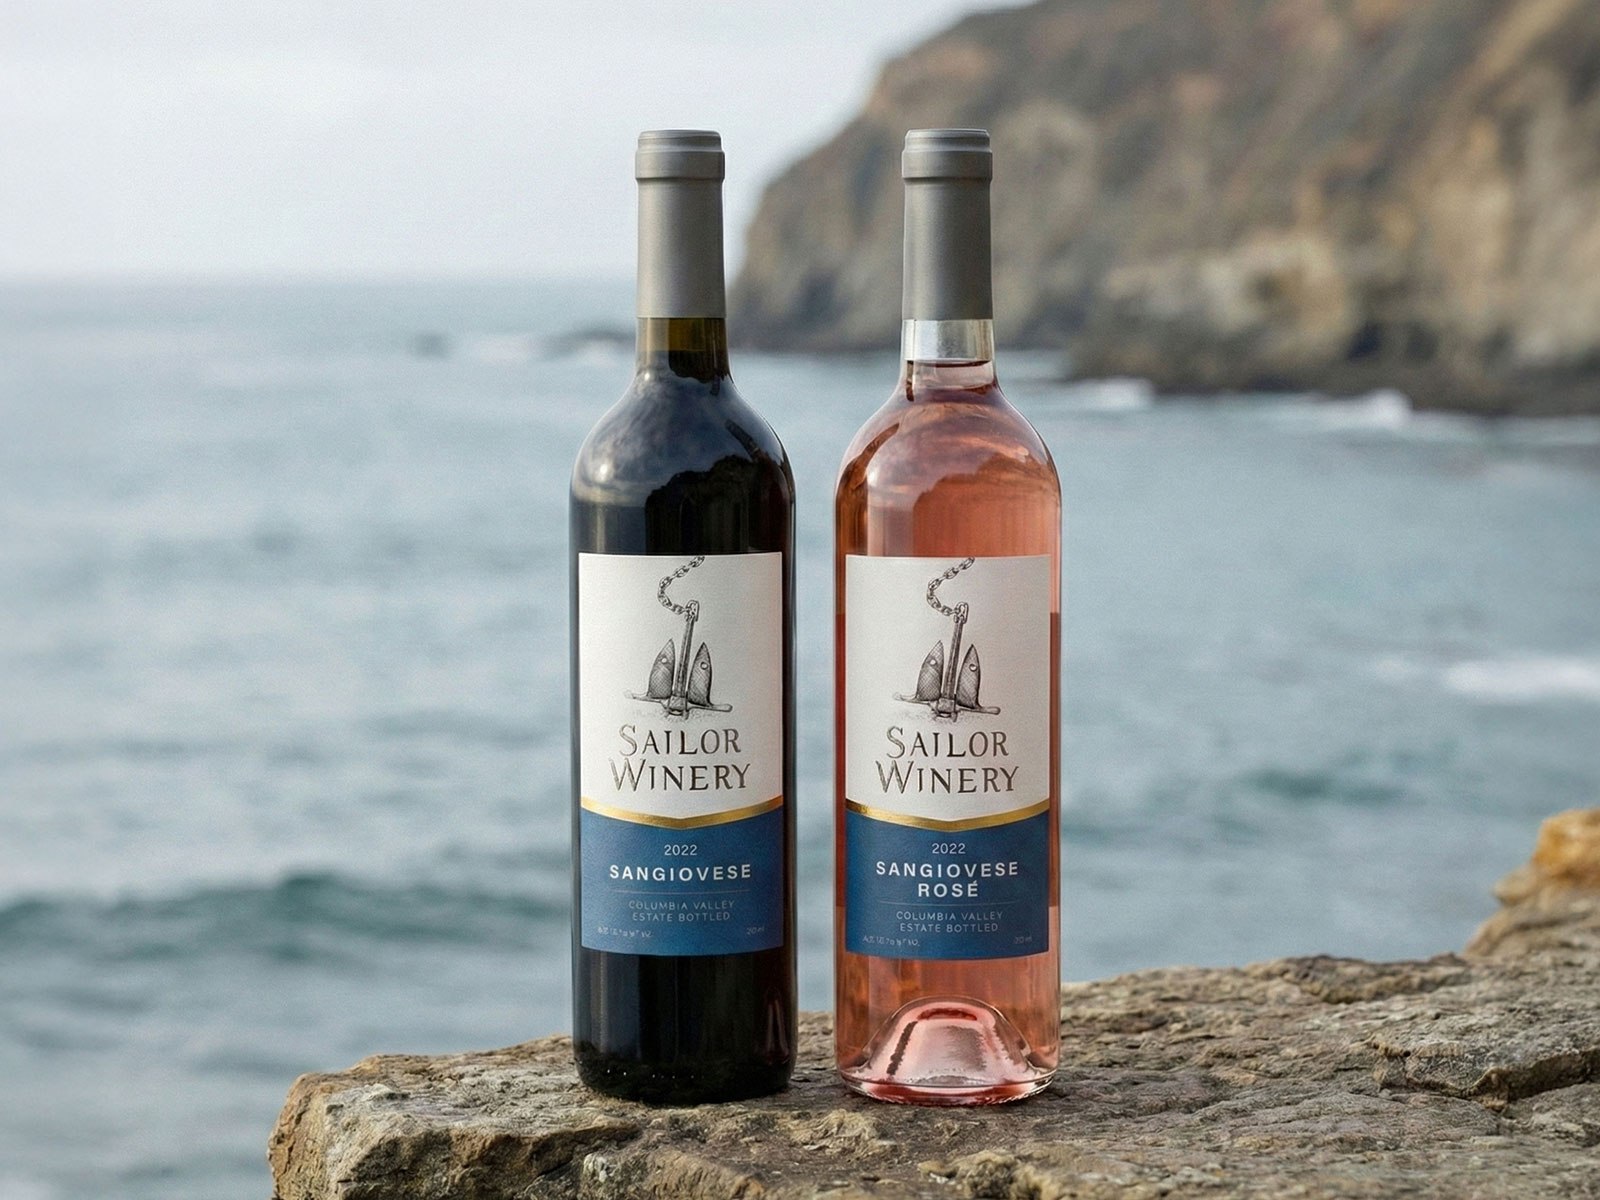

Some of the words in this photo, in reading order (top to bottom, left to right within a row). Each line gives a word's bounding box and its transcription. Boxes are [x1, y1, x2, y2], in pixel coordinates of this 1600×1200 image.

[619, 725, 742, 756] SAILOR
[886, 726, 1009, 759] SAILOR
[609, 757, 751, 792] WINERY
[876, 760, 1020, 794] WINERY
[664, 844, 698, 856] 2022
[931, 842, 966, 855] 2022
[609, 864, 751, 882] SANGIOVESE
[876, 861, 1018, 878] SANGIOVESE
[917, 880, 979, 898] ROSÉ
[629, 900, 688, 911] COLUMBIA
[694, 900, 735, 910] VALLEY
[632, 912, 673, 922] ESTATE
[679, 912, 730, 922] BOTTLED
[896, 911, 956, 921] COLUMBIA
[961, 911, 1004, 921] VALLEY
[900, 923, 941, 933] ESTATE
[946, 923, 999, 933] BOTTLED
